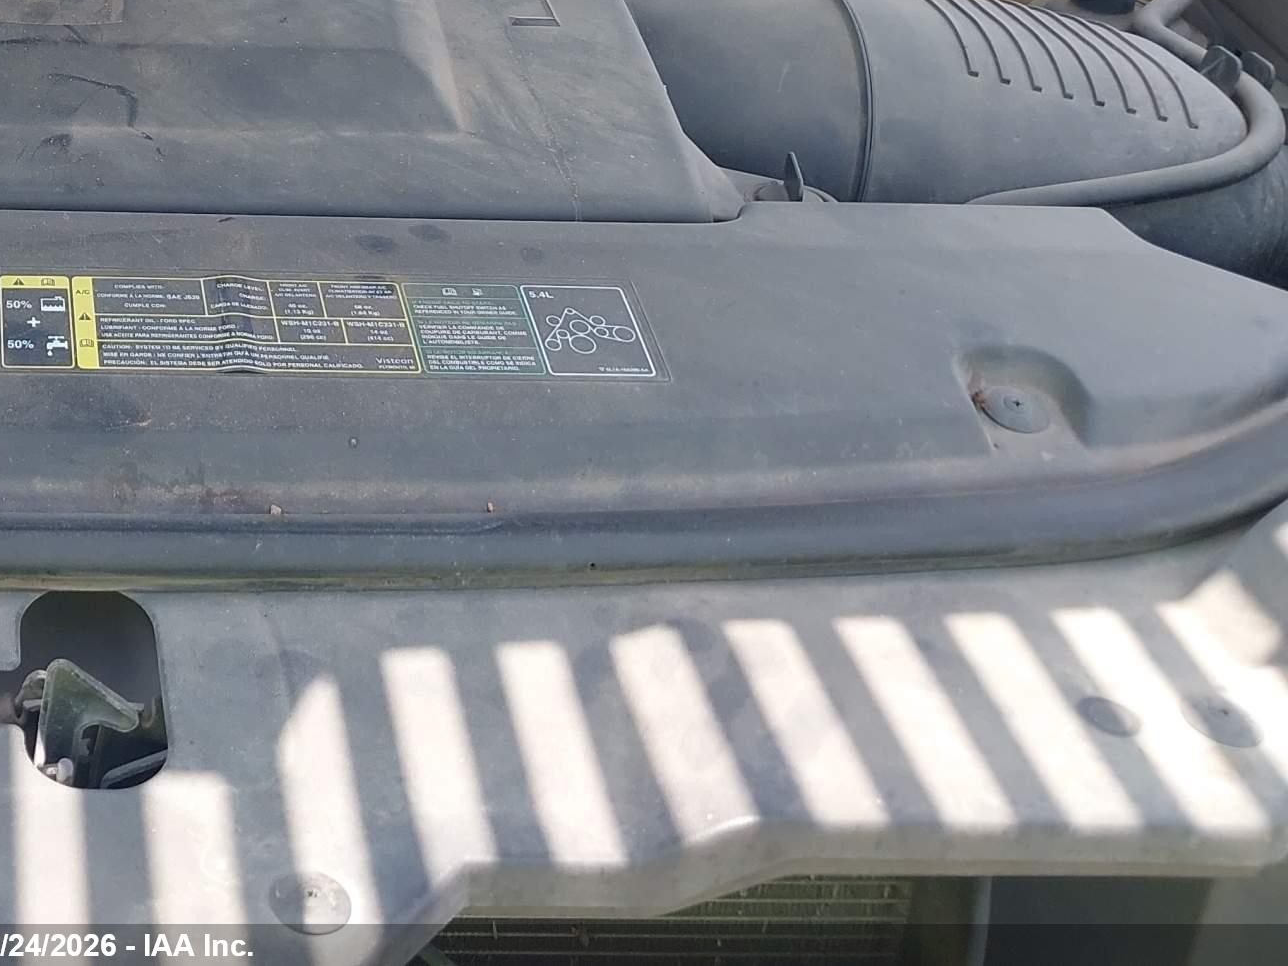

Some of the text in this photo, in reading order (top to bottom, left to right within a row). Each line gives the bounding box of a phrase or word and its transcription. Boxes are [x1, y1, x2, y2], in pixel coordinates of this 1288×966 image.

[528, 290, 554, 299] 5.4L
[6, 299, 32, 309] 50%
[7, 340, 34, 349] 50%
[221, 358, 253, 366] ATENDIDO
